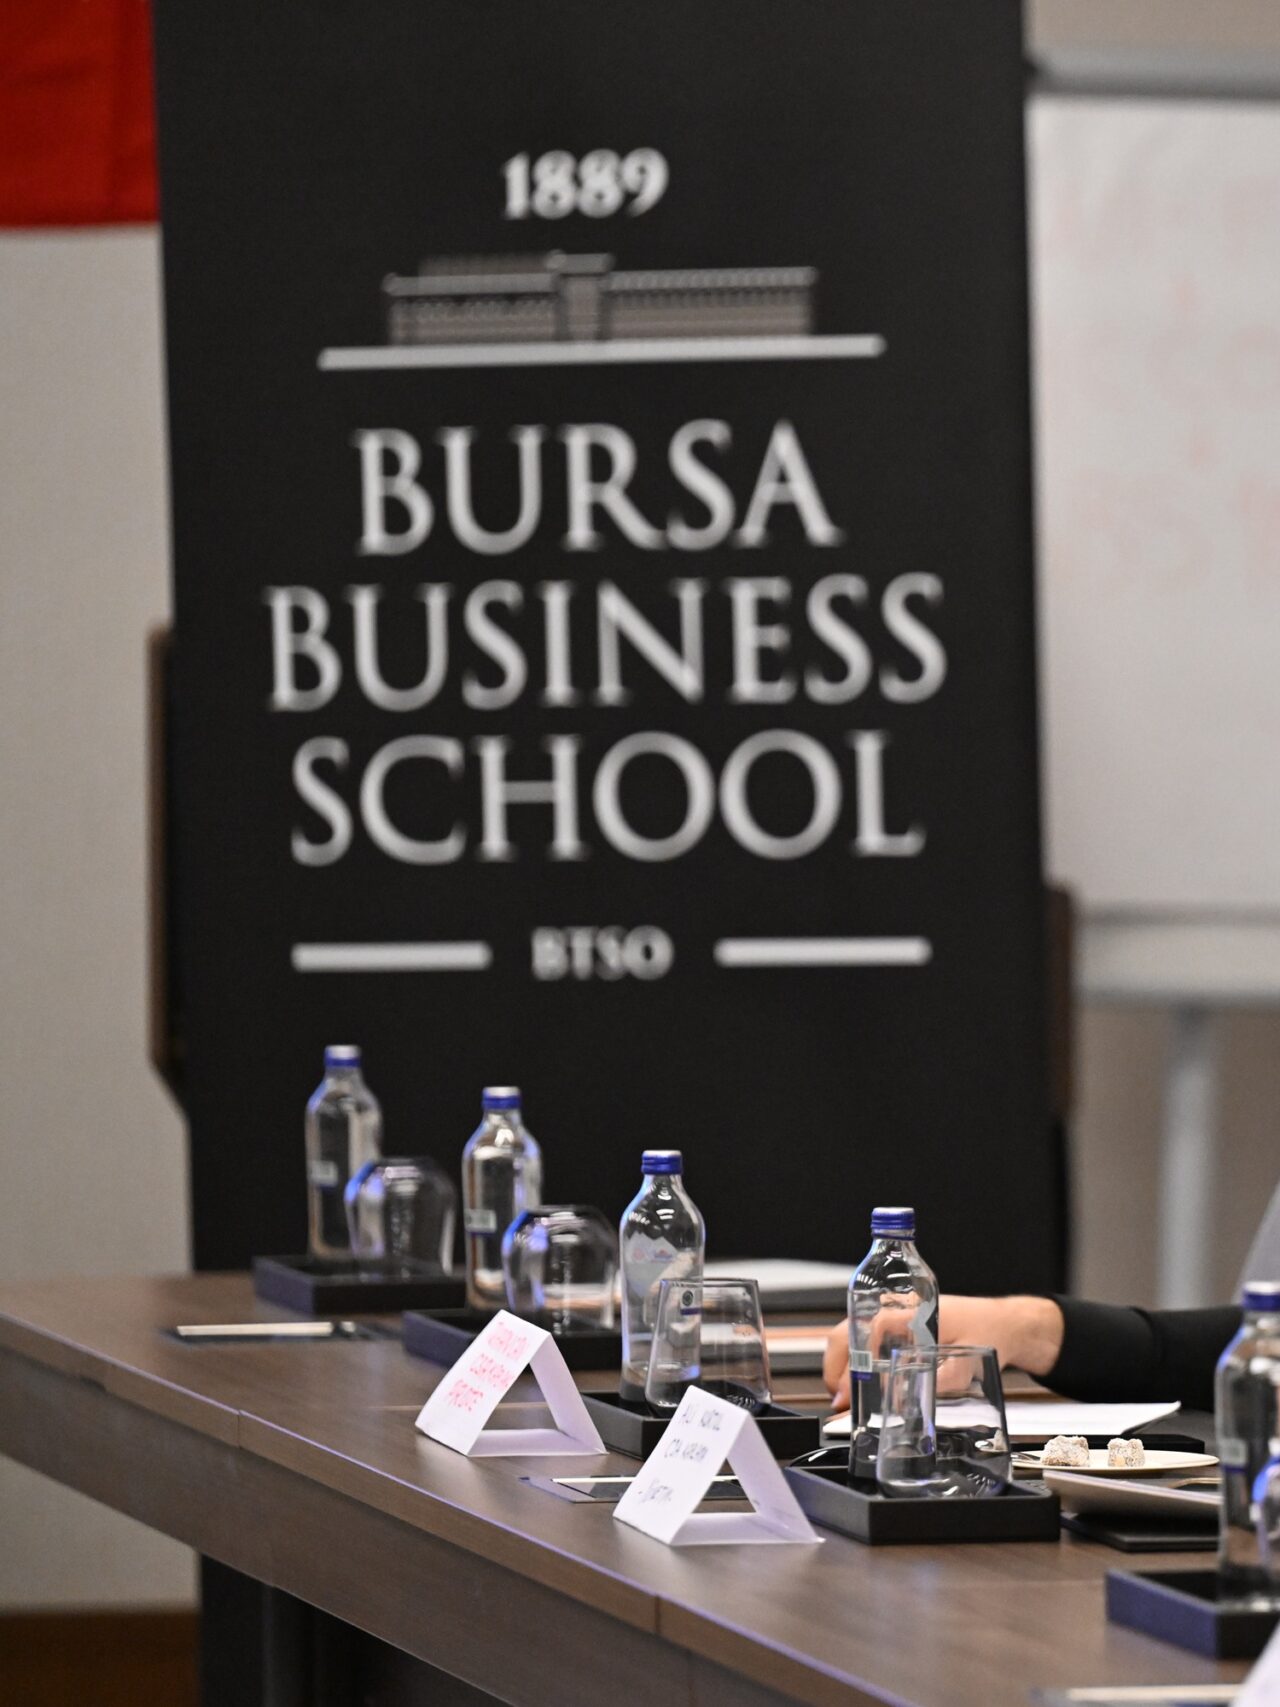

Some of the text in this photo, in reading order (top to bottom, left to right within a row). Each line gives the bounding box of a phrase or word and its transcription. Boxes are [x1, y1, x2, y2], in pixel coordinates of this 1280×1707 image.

[504, 147, 668, 219] 1889
[355, 418, 842, 556] BURSA
[265, 571, 947, 712] BUSINESS
[290, 729, 925, 866] SCHOOL
[530, 926, 675, 980] BTSO
